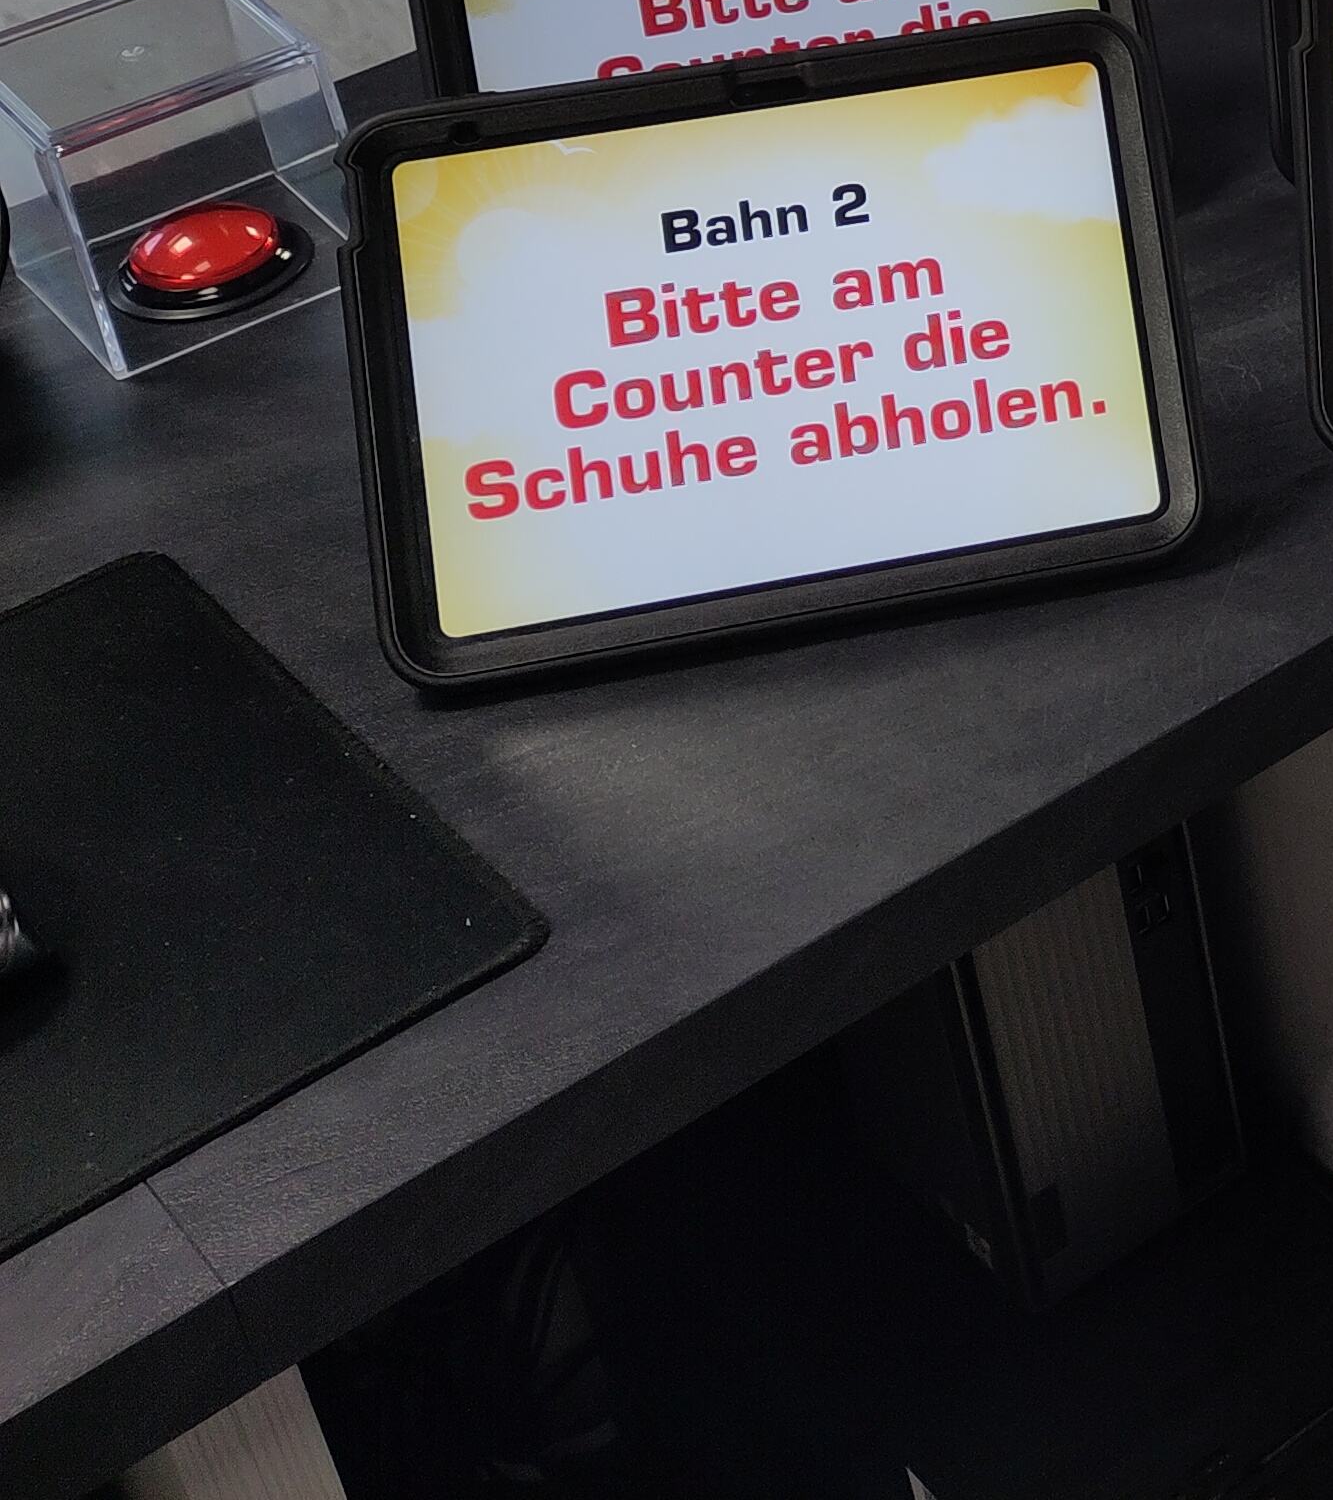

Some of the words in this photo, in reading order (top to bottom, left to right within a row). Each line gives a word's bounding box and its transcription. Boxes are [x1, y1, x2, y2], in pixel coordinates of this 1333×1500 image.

[661, 198, 808, 253] Bahn
[831, 183, 870, 227] 2
[603, 277, 801, 349] Bitte
[833, 256, 944, 308] am
[552, 337, 874, 429] Counter
[905, 309, 1010, 371] die
[464, 428, 757, 520] Schuhe
[790, 378, 1107, 465] abholen.
